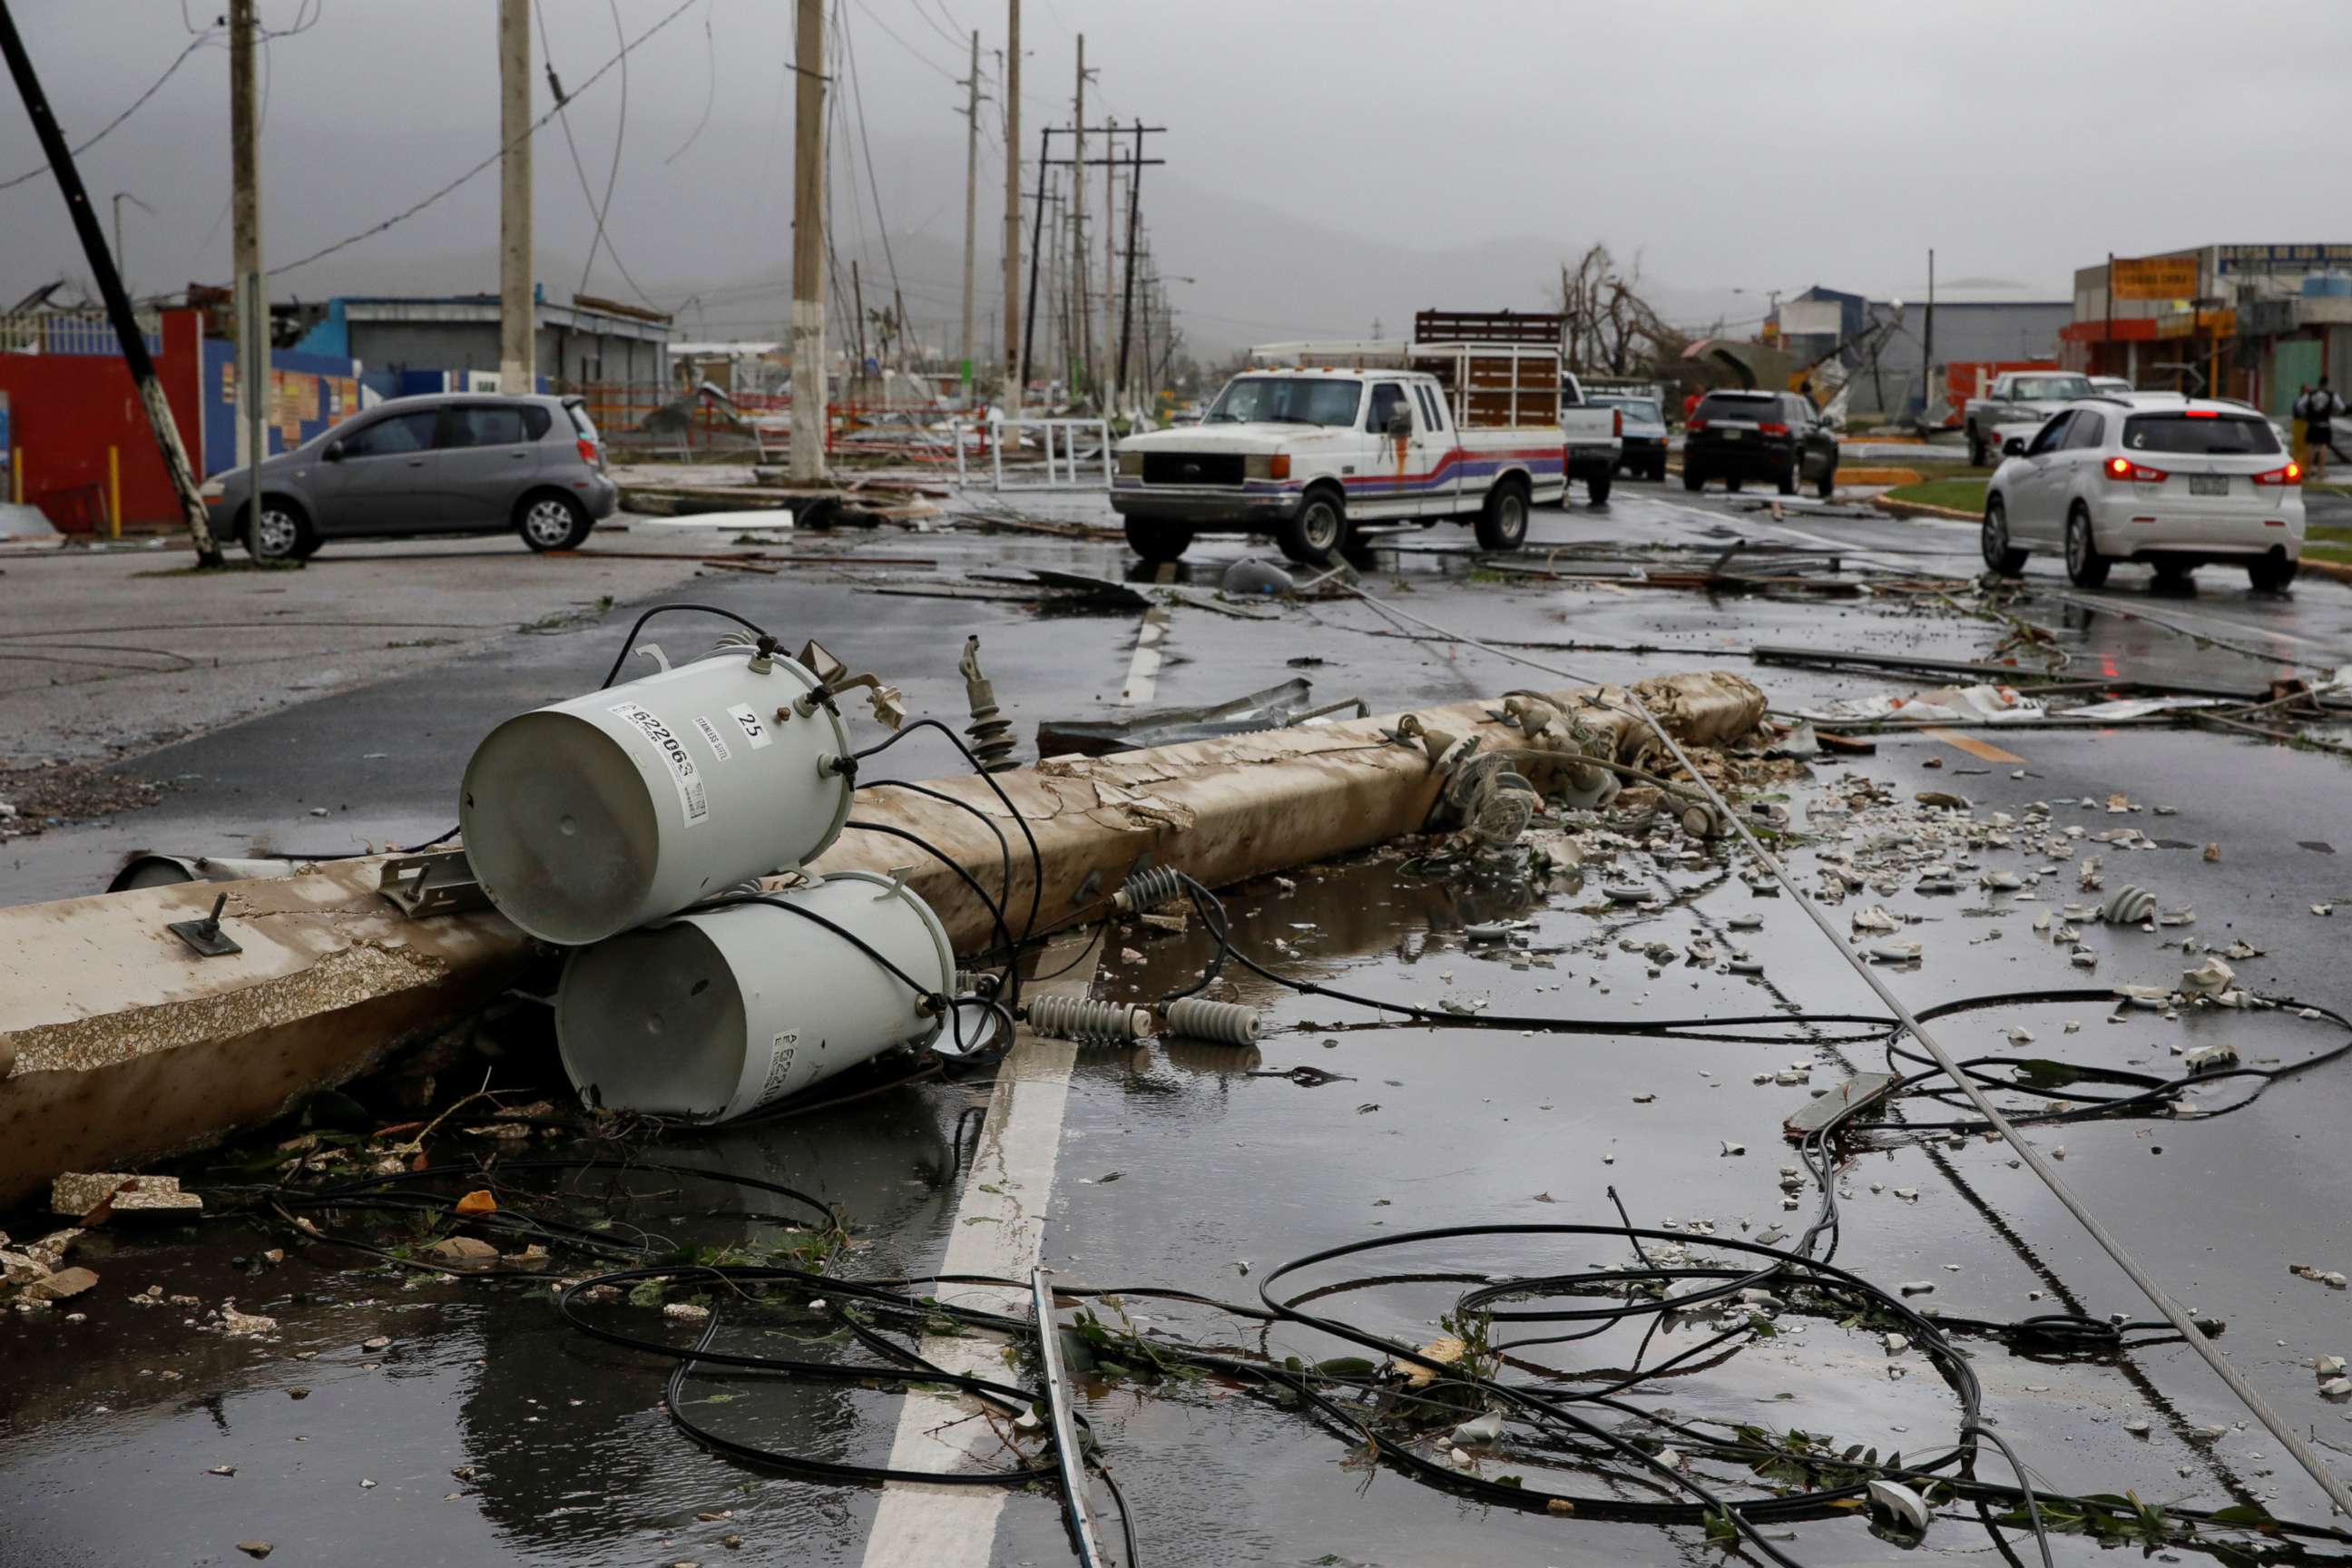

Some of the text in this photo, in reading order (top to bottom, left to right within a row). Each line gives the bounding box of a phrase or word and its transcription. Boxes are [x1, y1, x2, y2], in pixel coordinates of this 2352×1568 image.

[695, 717, 730, 761] STAINLESS STEEL
[738, 713, 764, 738] 25
